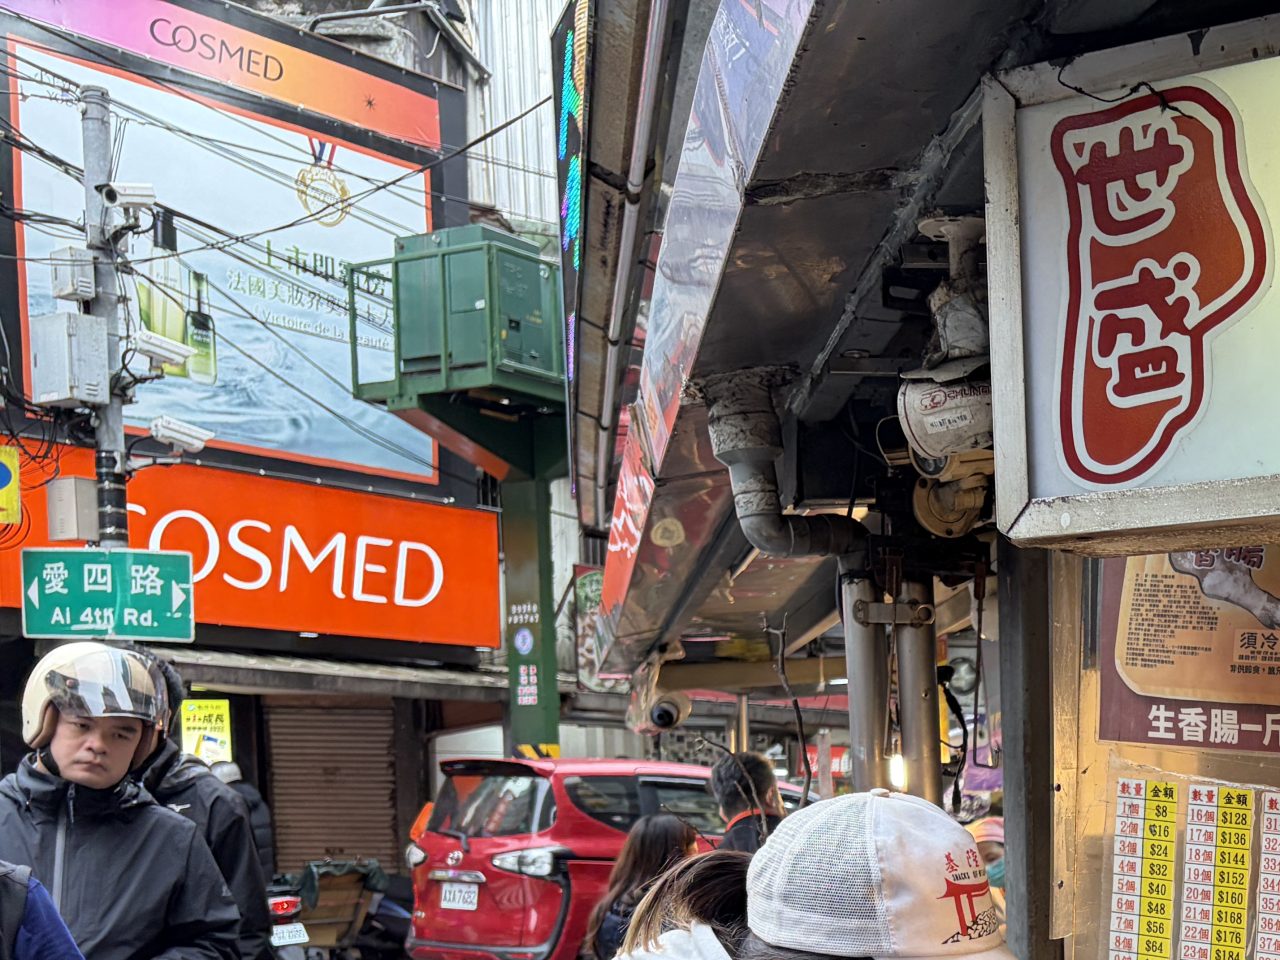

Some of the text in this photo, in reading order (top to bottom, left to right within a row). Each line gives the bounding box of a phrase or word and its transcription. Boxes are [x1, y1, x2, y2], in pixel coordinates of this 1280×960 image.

[150, 17, 284, 82] COSMED
[126, 501, 444, 608] OSMED
[42, 561, 165, 596] 愛四路
[123, 608, 158, 627] Rd.
[1119, 782, 1174, 800] 數量 金額
[1192, 789, 1248, 807] 數量 金額
[1154, 804, 1168, 818] $8
[1190, 809, 1248, 826] 16個 $128
[1120, 820, 1139, 836] 2個
[1189, 828, 1247, 846] 17個 $136
[1119, 840, 1168, 857] 3個 $24
[1188, 847, 1246, 865] 18個 $144
[1118, 859, 1167, 876] 4個 $32
[1187, 867, 1245, 885] 19個 $152
[1118, 878, 1166, 895] 5個 $40
[1186, 886, 1243, 904] 20個 $160
[1117, 897, 1165, 914] 6個 $48
[1185, 905, 1242, 924] 21個 $168
[1116, 916, 1164, 933] 7個 $56
[1184, 925, 1241, 944] 22個 $176
[1115, 935, 1163, 953] 8個 $64
[1184, 944, 1208, 958] 23個
